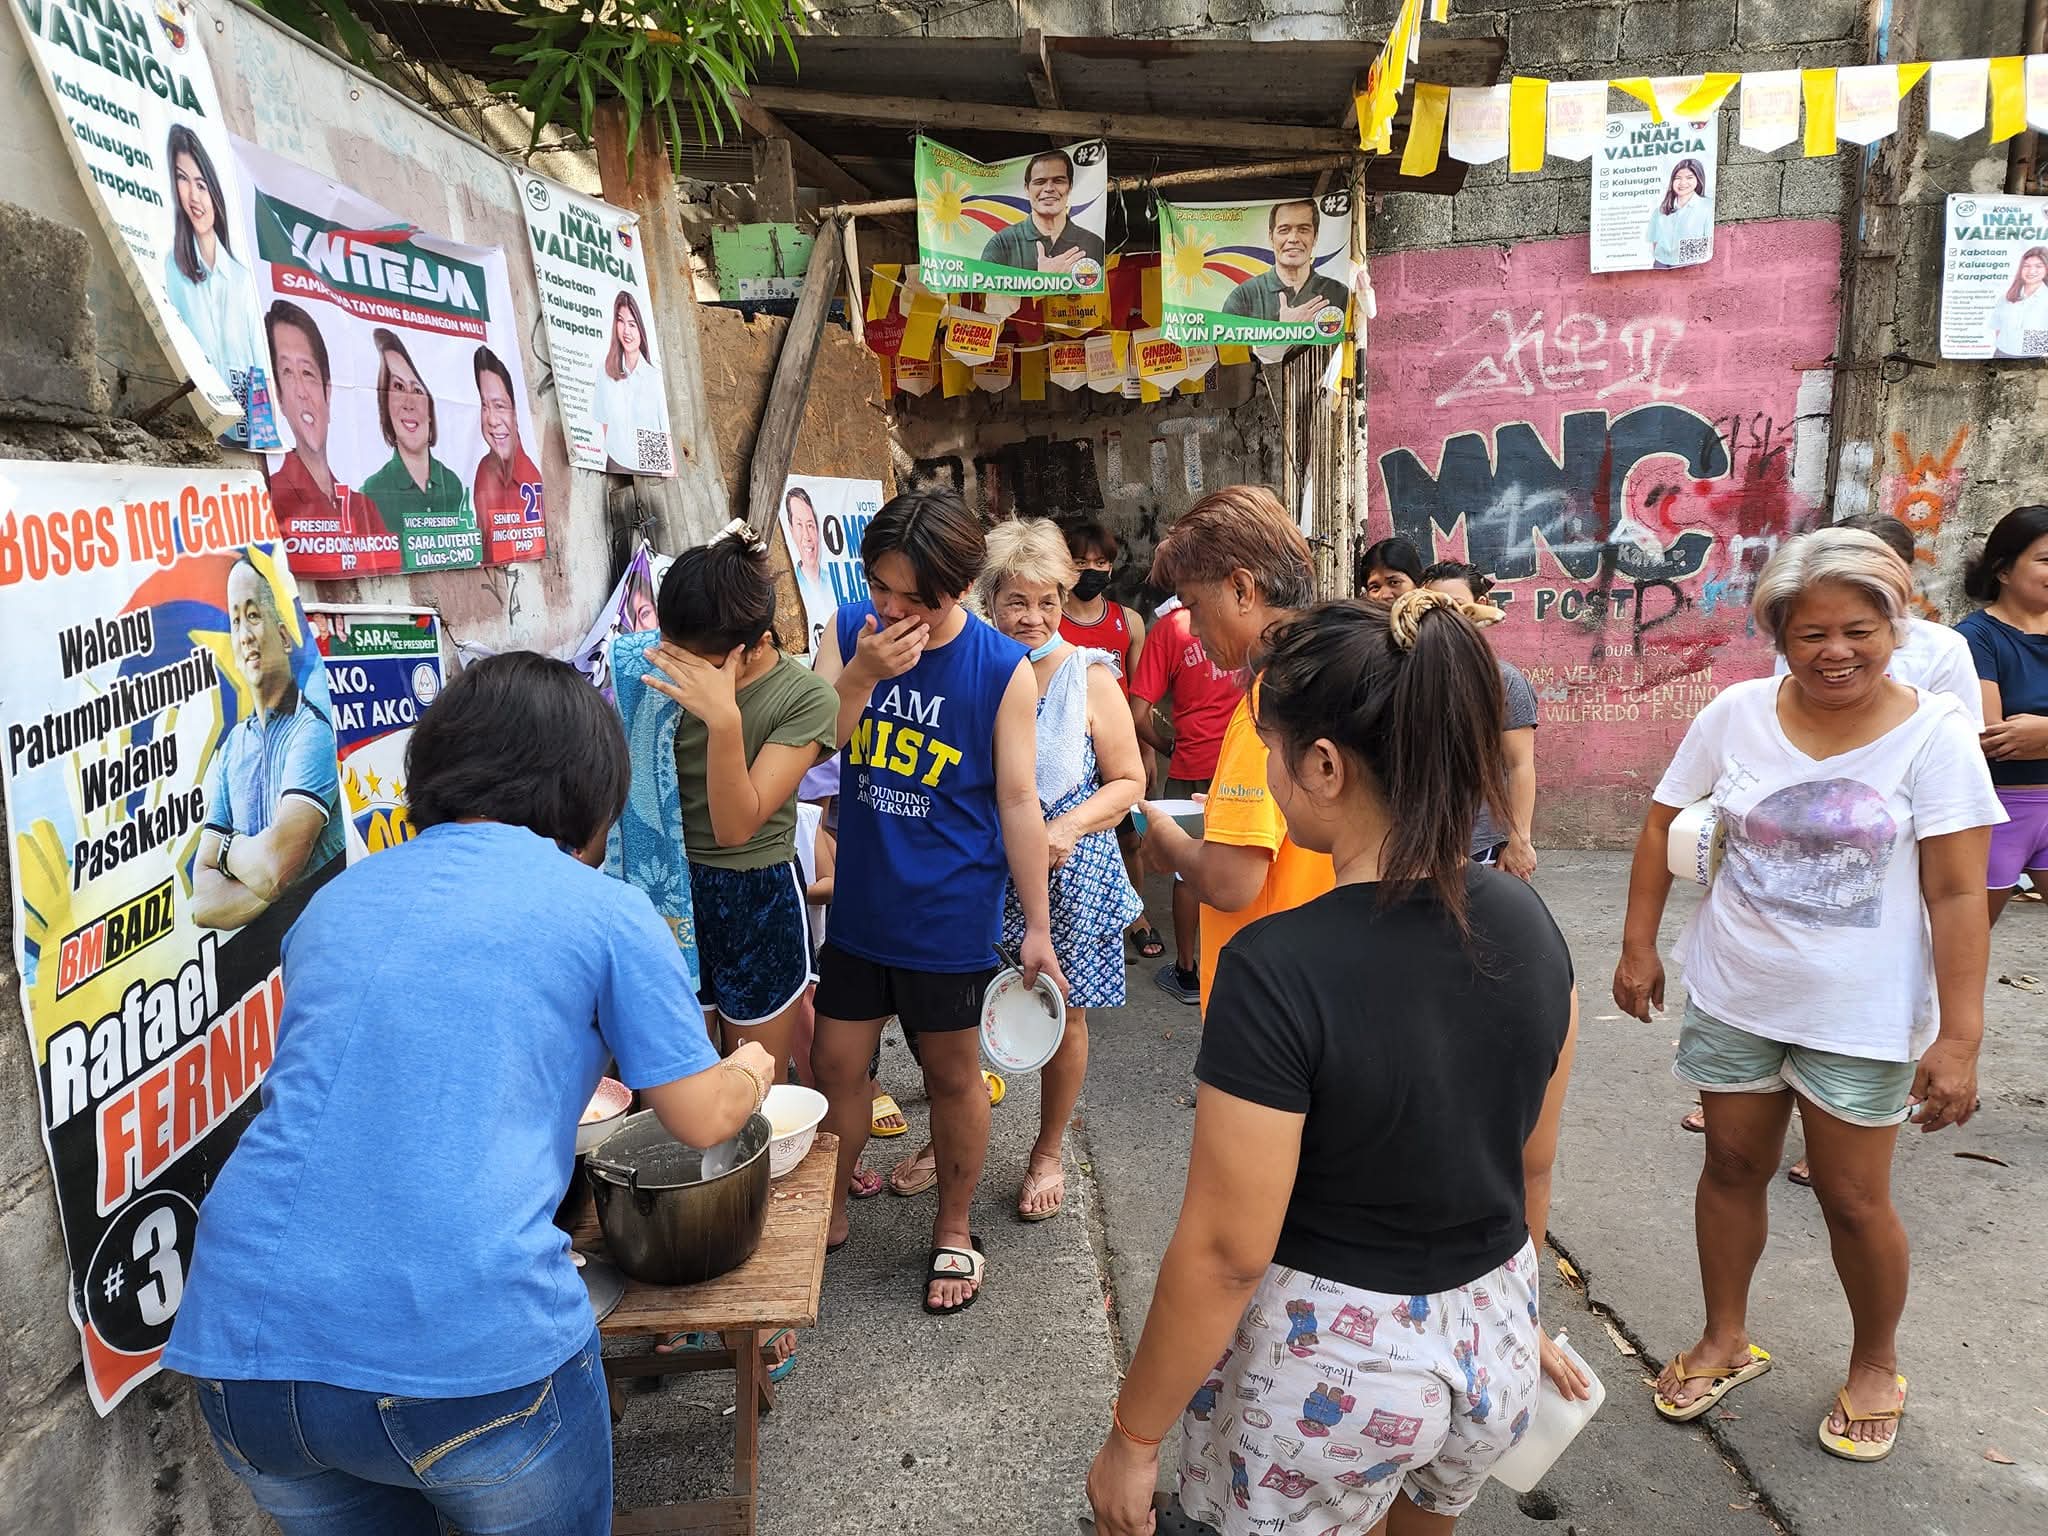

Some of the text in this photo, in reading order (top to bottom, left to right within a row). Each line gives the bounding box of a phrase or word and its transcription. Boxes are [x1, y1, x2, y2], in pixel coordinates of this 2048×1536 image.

[13, 0, 206, 118] VALENCIA
[51, 70, 141, 129] Kabataan
[1630, 127, 1680, 144] INAH
[1077, 146, 1099, 164] #2
[1604, 138, 1706, 160] VALENCIA
[1612, 165, 1658, 175] Kabataan
[88, 162, 164, 208] arapatan
[1612, 177, 1661, 187] Kalusugan
[1612, 188, 1661, 198] Karapatan
[1324, 195, 1348, 213] #2
[1176, 211, 1198, 221] PARA
[1982, 213, 2033, 226] INAH
[559, 211, 612, 253] INAH
[530, 223, 638, 287] VALENCIA
[921, 255, 965, 272] MAYOR
[1960, 248, 2008, 257] Kabataan
[1958, 261, 2010, 270] Kalusugan
[544, 269, 596, 297] Kabataan
[922, 271, 1074, 291] ALVIN PATRIMONIO
[1956, 273, 2009, 282] Karapatan
[350, 299, 400, 319] TAYONG
[402, 310, 460, 330] BABANGON
[546, 291, 603, 318] Kalusugan
[549, 313, 603, 339] Karapatan
[1164, 312, 1205, 325] MAYOR
[952, 334, 991, 348] SAN MIGUEL
[953, 322, 993, 341] GINEBRA
[1164, 324, 1317, 342] ALVIN PATRIMONIO
[1054, 347, 1086, 360] GINEBRA
[1142, 342, 1182, 360] GINEBRA
[1143, 359, 1158, 369] SAN
[1158, 354, 1183, 366] MIGUEL
[1378, 402, 1732, 584] MNC
[335, 482, 353, 534] 7
[459, 486, 477, 530] 4
[0, 483, 281, 586] Boses ng Cainta
[408, 532, 482, 550] SARA DUTERTE
[415, 549, 474, 567] Lakas-CMD
[1535, 587, 1634, 622] POST
[58, 610, 152, 680] Walang
[354, 629, 392, 647] SARA
[8, 648, 218, 777] Patumpiktumpik
[372, 697, 419, 727] AKO!
[877, 684, 946, 728] AM
[1545, 703, 1640, 726] WILFREDO
[849, 718, 963, 788] MIST
[81, 732, 178, 815] Walang
[869, 784, 931, 806] OUNDING
[72, 785, 205, 892] Pasakalye
[50, 934, 219, 1128] Rafael
[102, 966, 286, 1210] FERNA
